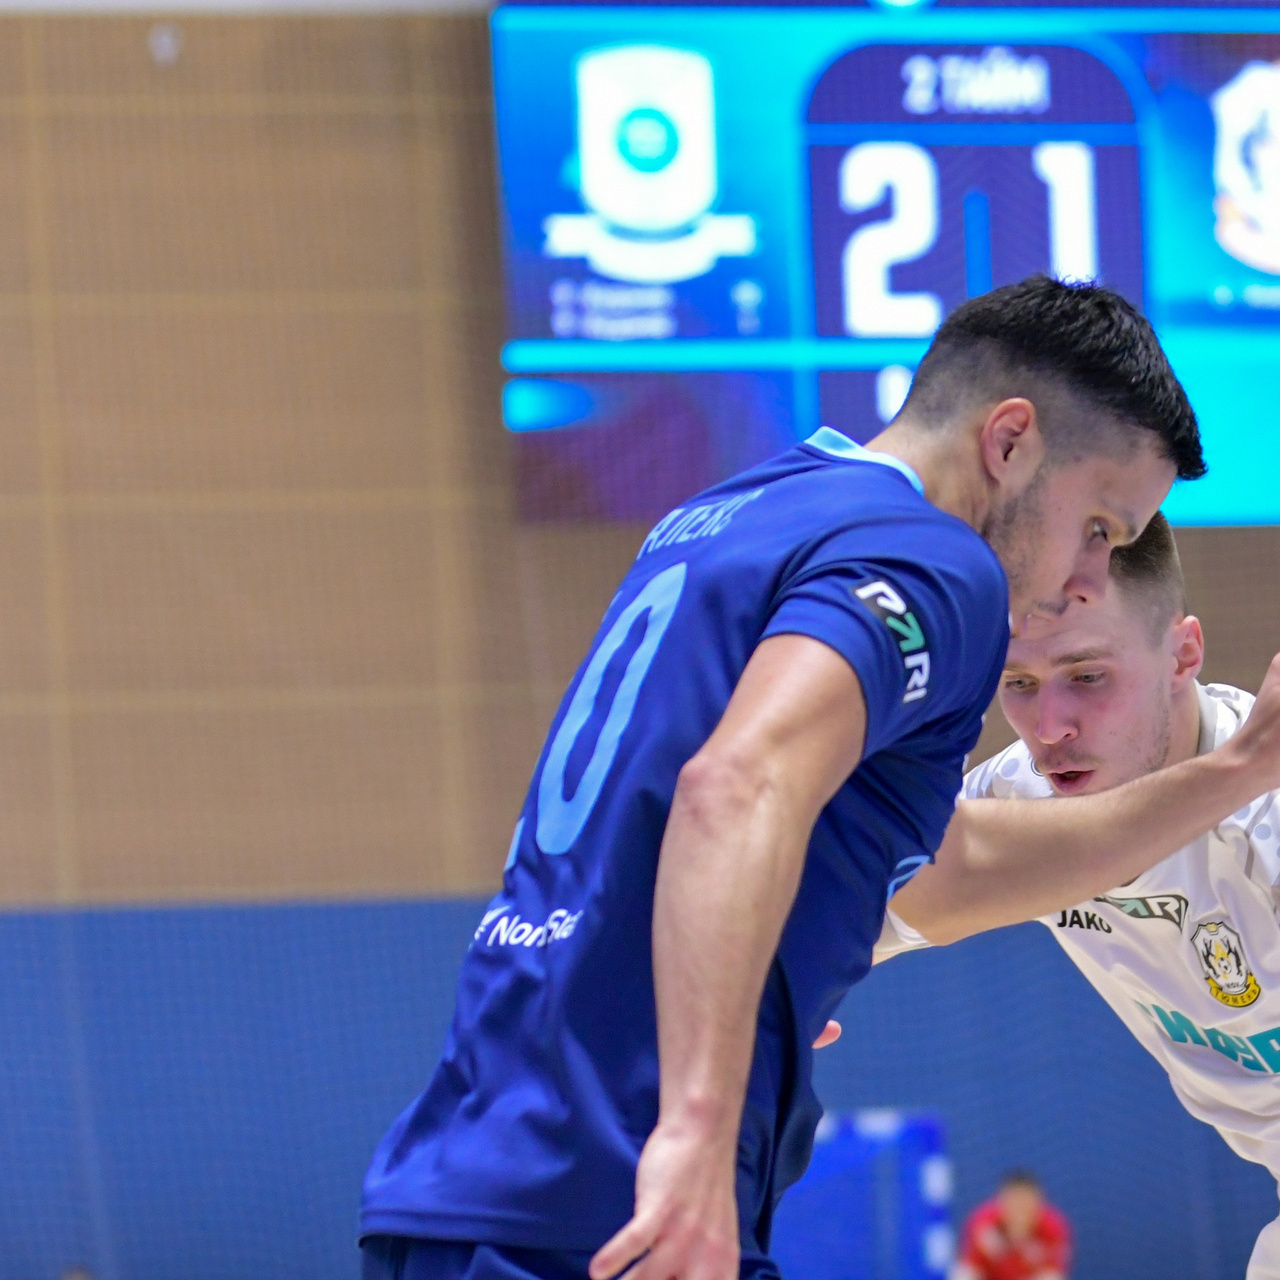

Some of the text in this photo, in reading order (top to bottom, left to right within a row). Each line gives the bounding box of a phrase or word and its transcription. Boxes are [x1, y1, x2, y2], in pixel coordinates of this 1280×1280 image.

[902, 54, 939, 115] 2
[841, 142, 942, 338] 2
[1033, 142, 1098, 284] 1
[855, 581, 930, 704] PARI
[504, 561, 687, 871] 0
